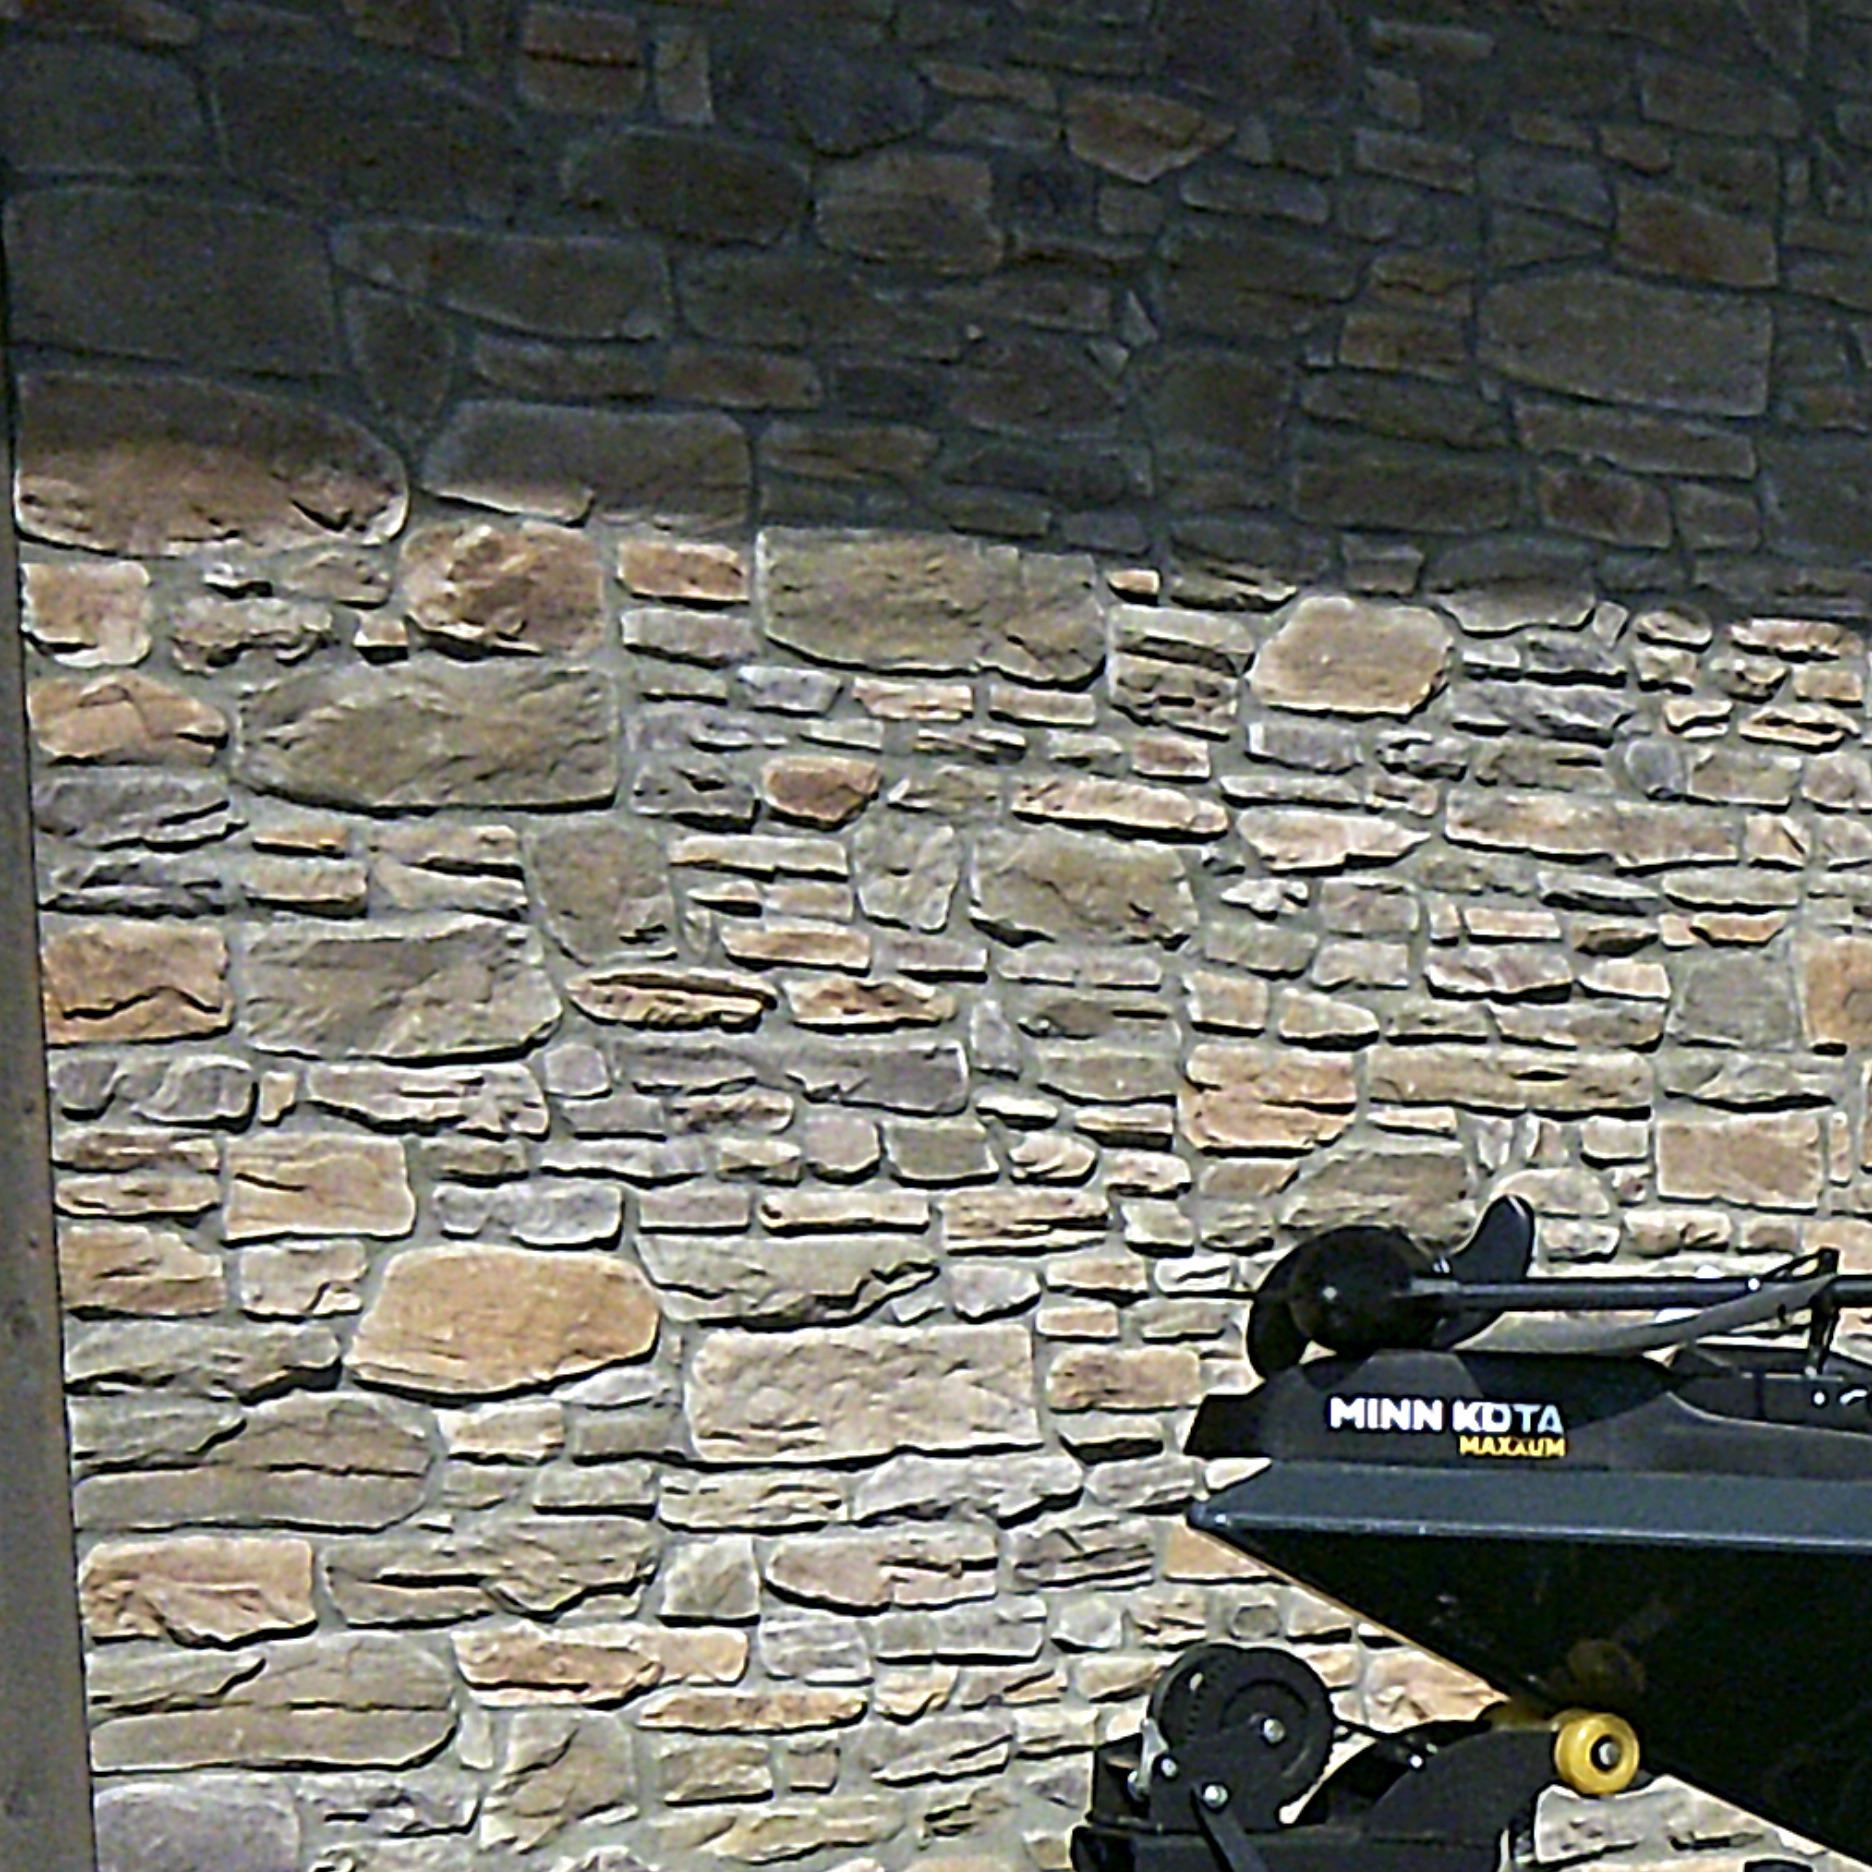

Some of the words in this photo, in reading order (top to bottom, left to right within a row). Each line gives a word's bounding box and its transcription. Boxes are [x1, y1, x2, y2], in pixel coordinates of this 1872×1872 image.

[1329, 1397, 1445, 1430] MINN
[1452, 1399, 1564, 1434] KOTA
[1459, 1435, 1567, 1458] MAXXUM
